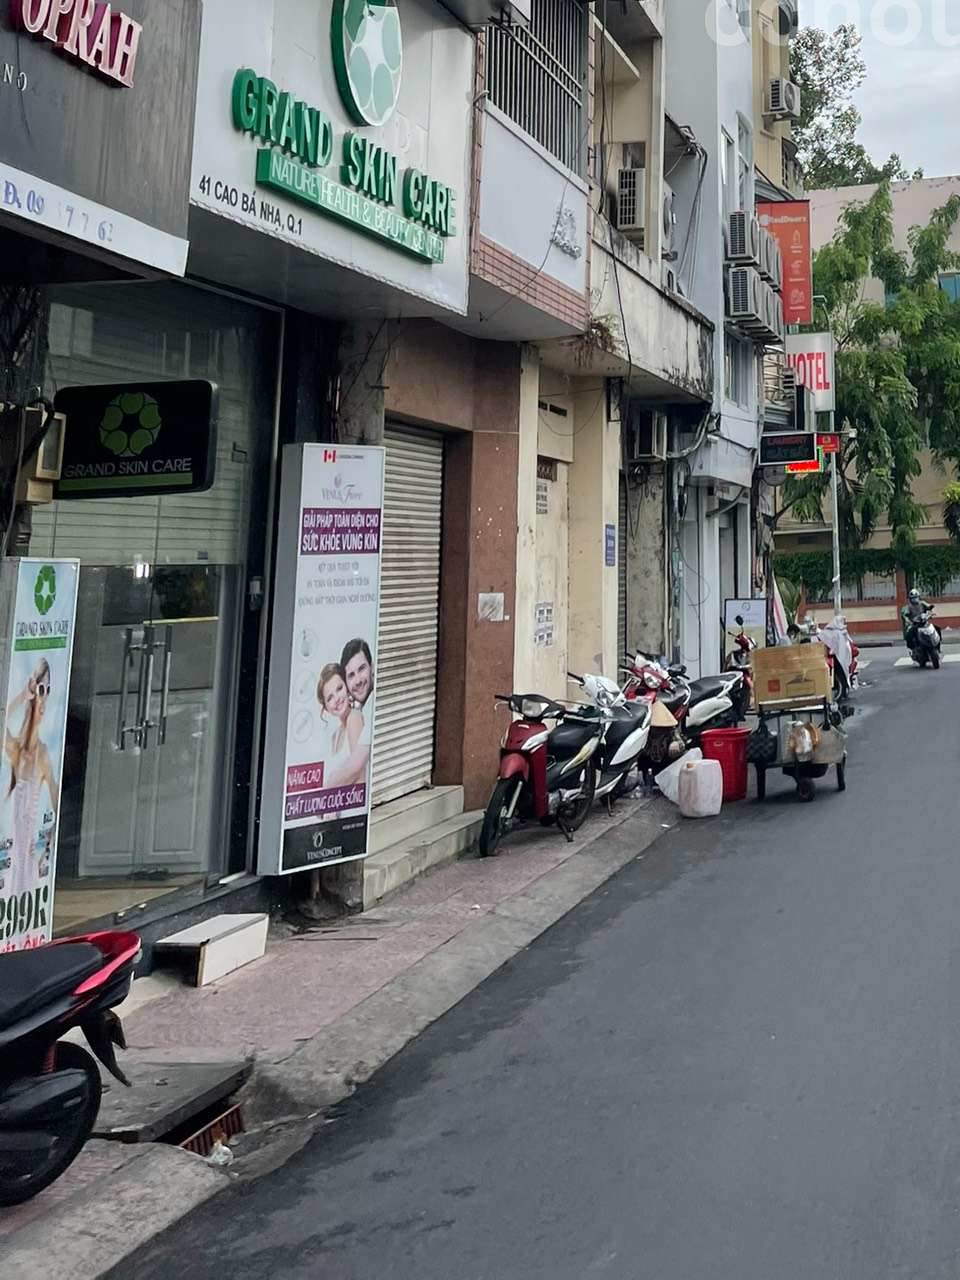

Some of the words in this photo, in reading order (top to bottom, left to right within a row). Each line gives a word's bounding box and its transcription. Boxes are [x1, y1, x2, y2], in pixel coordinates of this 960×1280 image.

[232, 66, 333, 168] GRAND
[341, 131, 398, 205] SKIN
[403, 167, 456, 237] CARE
[199, 175, 210, 196] 41
[215, 181, 238, 207] CAO
[241, 190, 256, 216] BÁ
[260, 201, 285, 231] NHẠ,
[287, 214, 303, 235] Q.1
[271, 153, 318, 200] NATURE
[320, 175, 360, 220] HEALTH
[362, 198, 373, 221] &
[375, 206, 410, 243] BEAUTY
[64, 462, 115, 477] GRAND
[119, 460, 148, 474] SKIN
[151, 457, 192, 471] CARE
[303, 509, 317, 528] GIẢI
[317, 511, 333, 528] PHÁP
[334, 511, 350, 528] TOÀN
[351, 511, 365, 531] DIỆN
[366, 513, 379, 527] CHO
[302, 529, 319, 551] SỨC
[319, 528, 341, 551] KHỎE
[341, 529, 363, 550] VÙNG
[364, 529, 379, 550] KÍN
[288, 769, 306, 787] NÂNG
[307, 768, 321, 784] CAO
[286, 796, 304, 816] CHẤT
[304, 795, 327, 814] LƯỢNG
[327, 789, 345, 809] CUỘC
[345, 786, 364, 805] SỐNG
